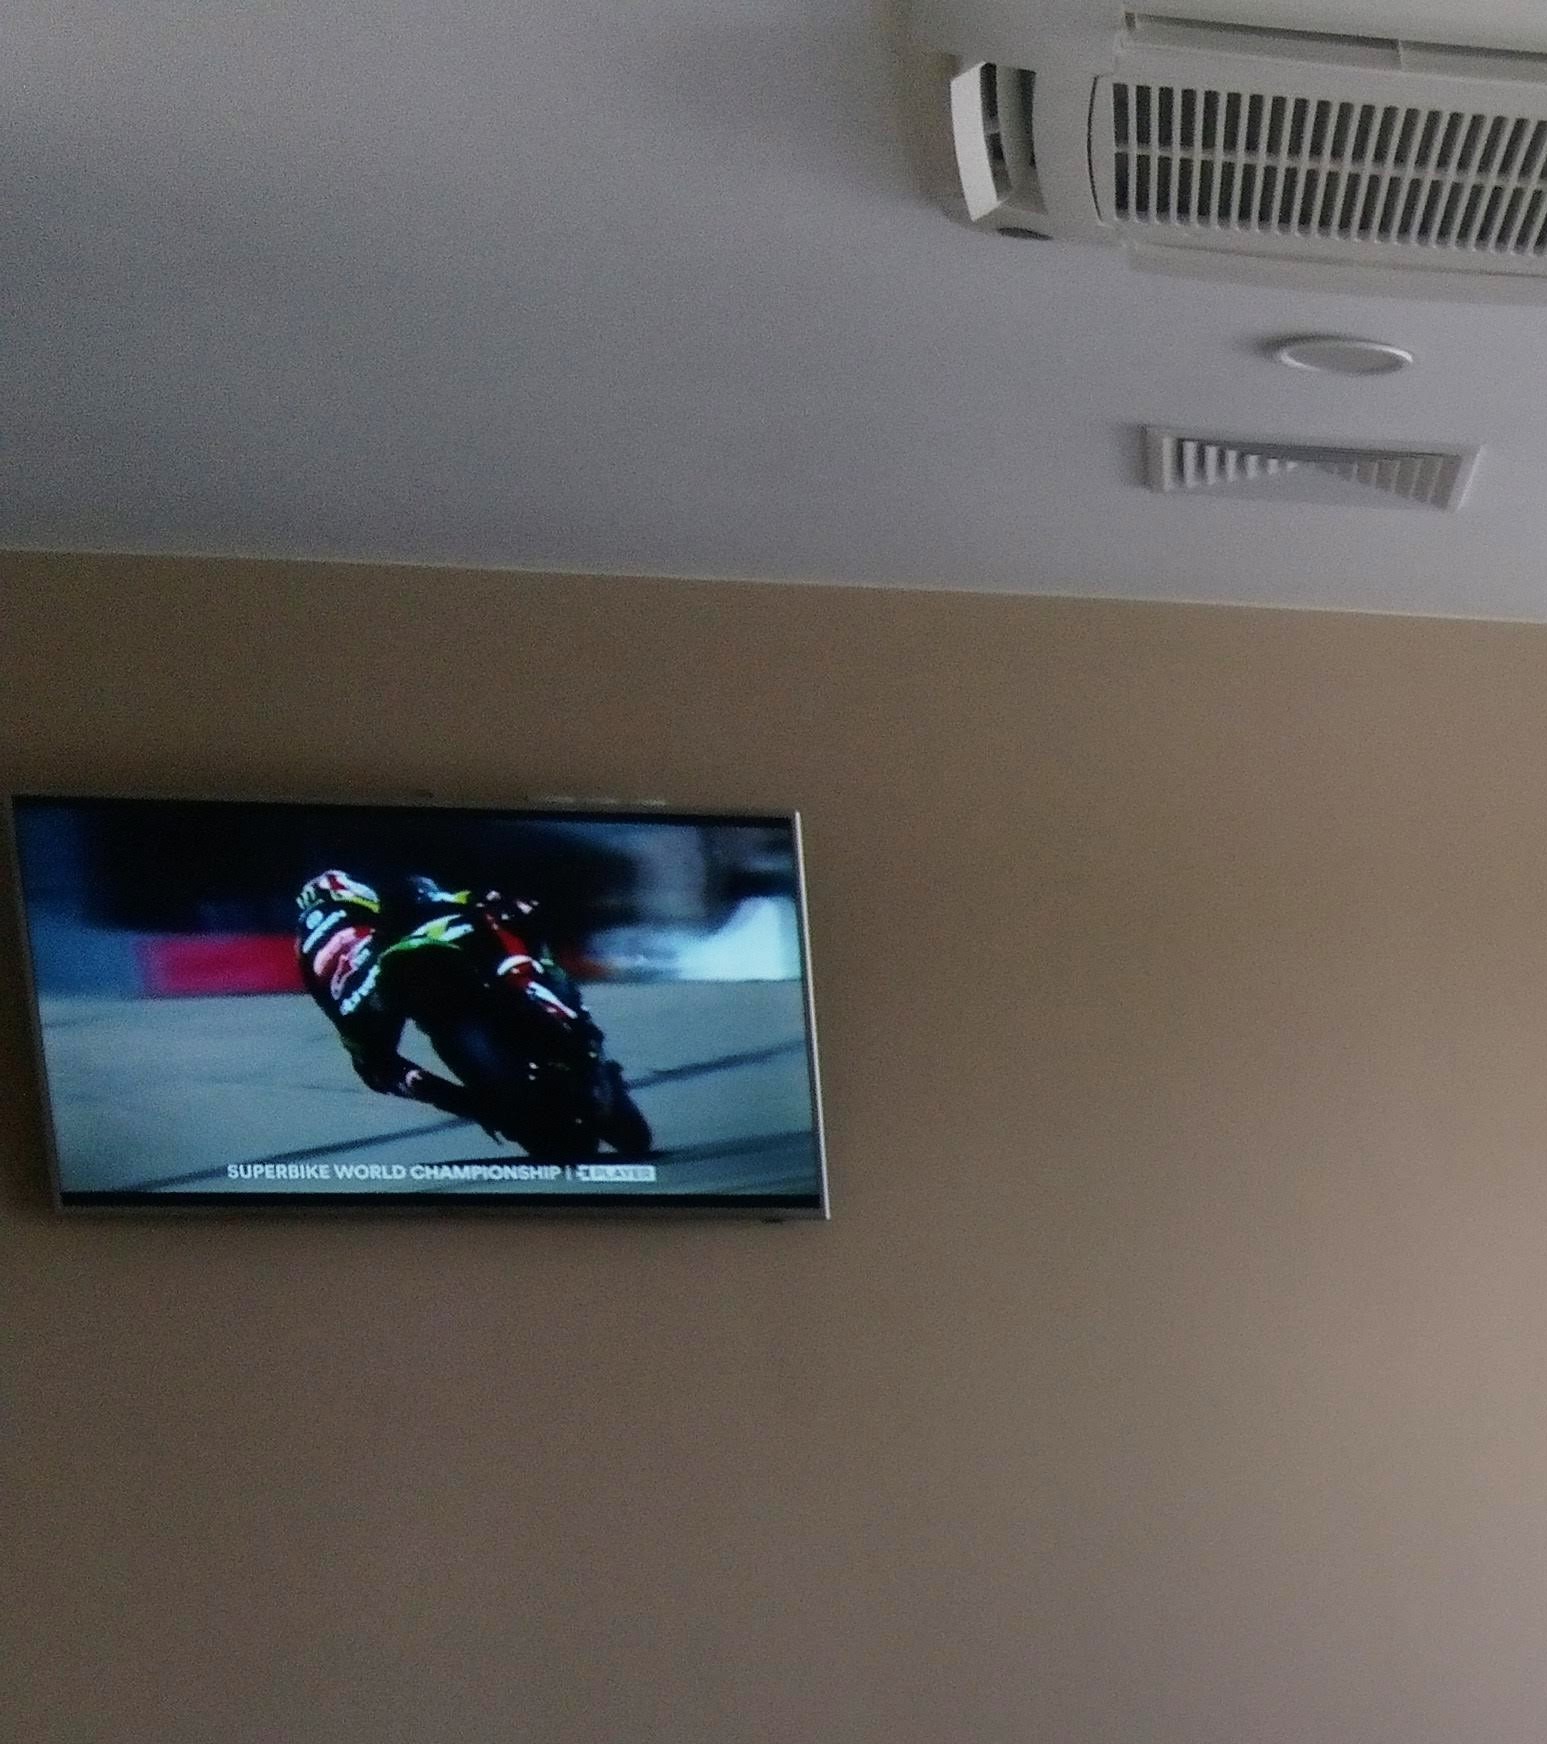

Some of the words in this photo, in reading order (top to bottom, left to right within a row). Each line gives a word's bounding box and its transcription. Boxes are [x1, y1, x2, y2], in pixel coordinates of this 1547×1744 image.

[226, 1163, 331, 1180] SUPERBIKE
[333, 1164, 407, 1180] WORLD
[410, 1164, 562, 1181] CHAMPIONSHIP
[593, 1166, 653, 1180] PLAYER
